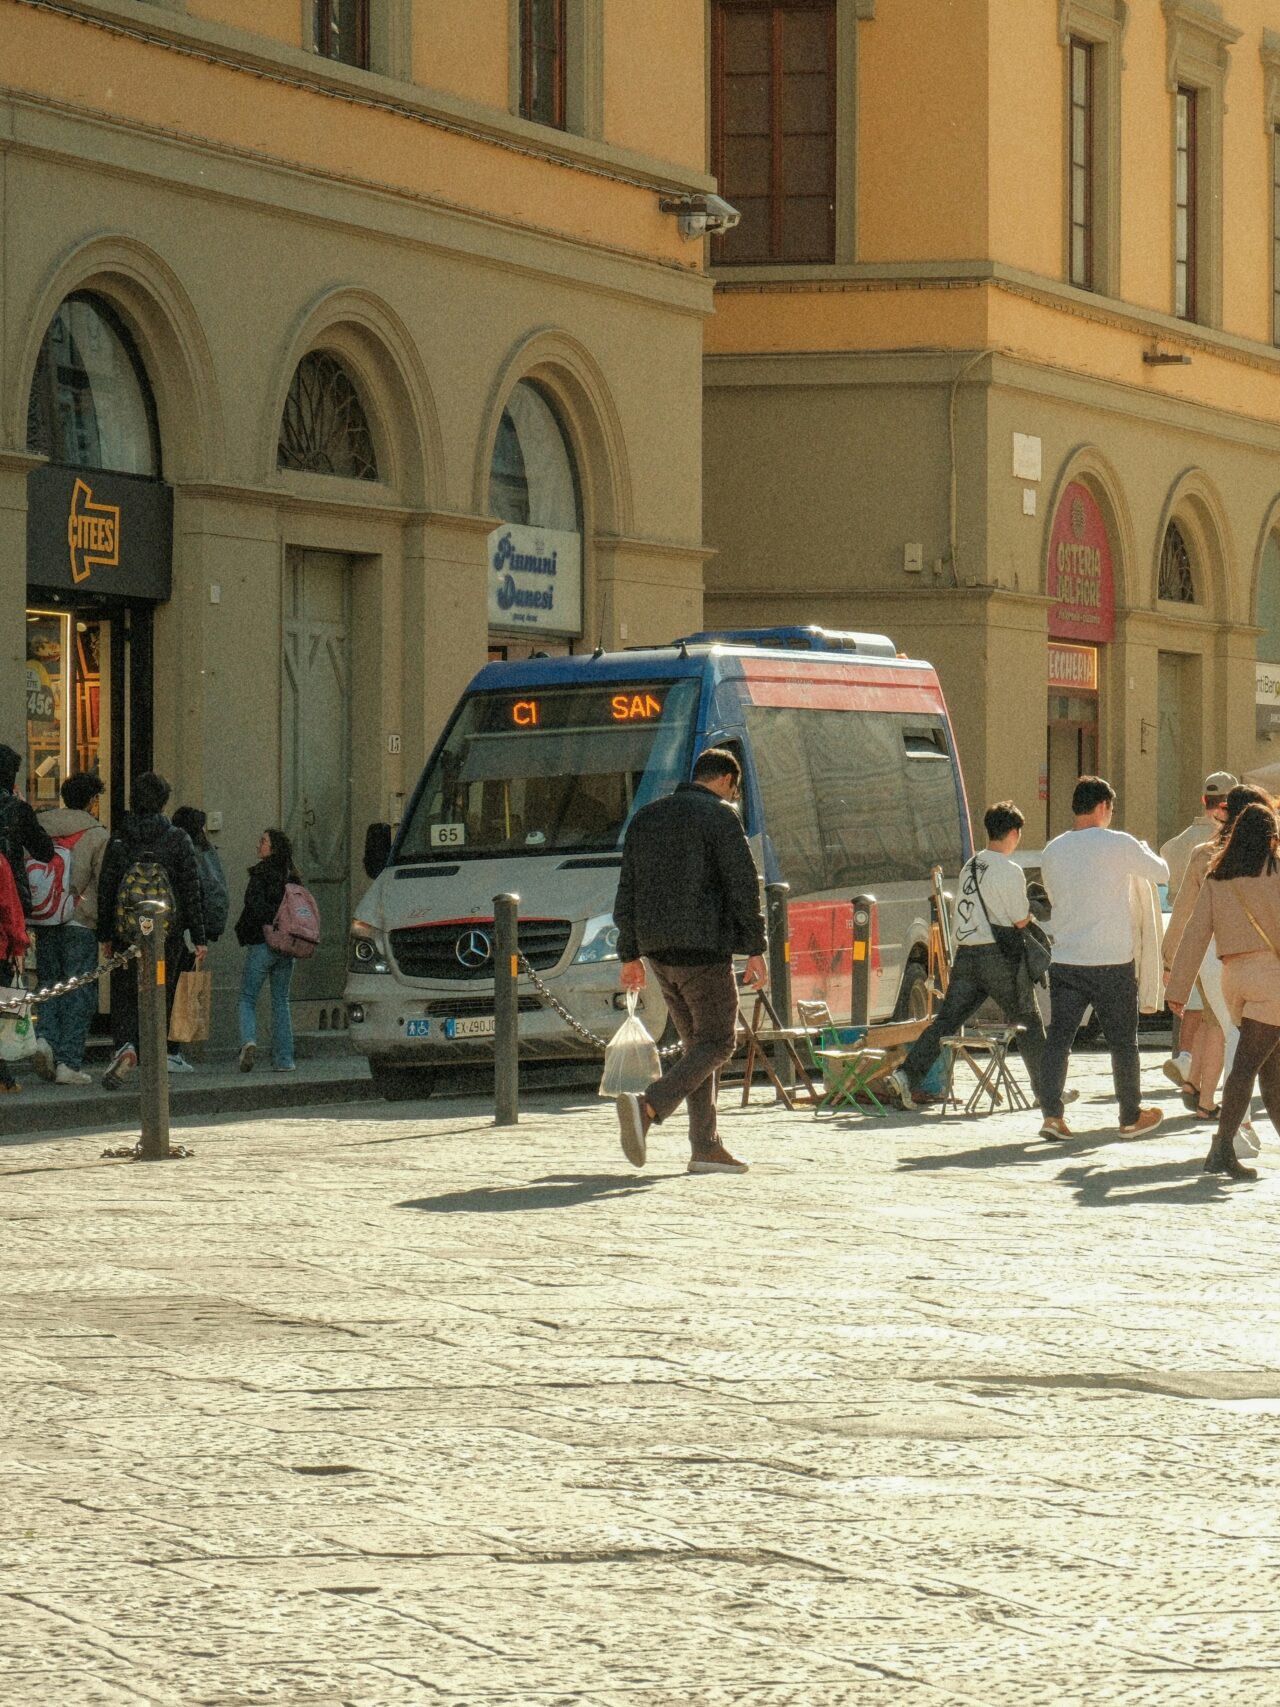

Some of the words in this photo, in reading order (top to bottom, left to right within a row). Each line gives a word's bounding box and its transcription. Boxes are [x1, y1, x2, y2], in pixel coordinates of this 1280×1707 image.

[1057, 542, 1101, 577] OSTERIA
[513, 702, 536, 724] C1
[438, 828, 458, 843] 65
